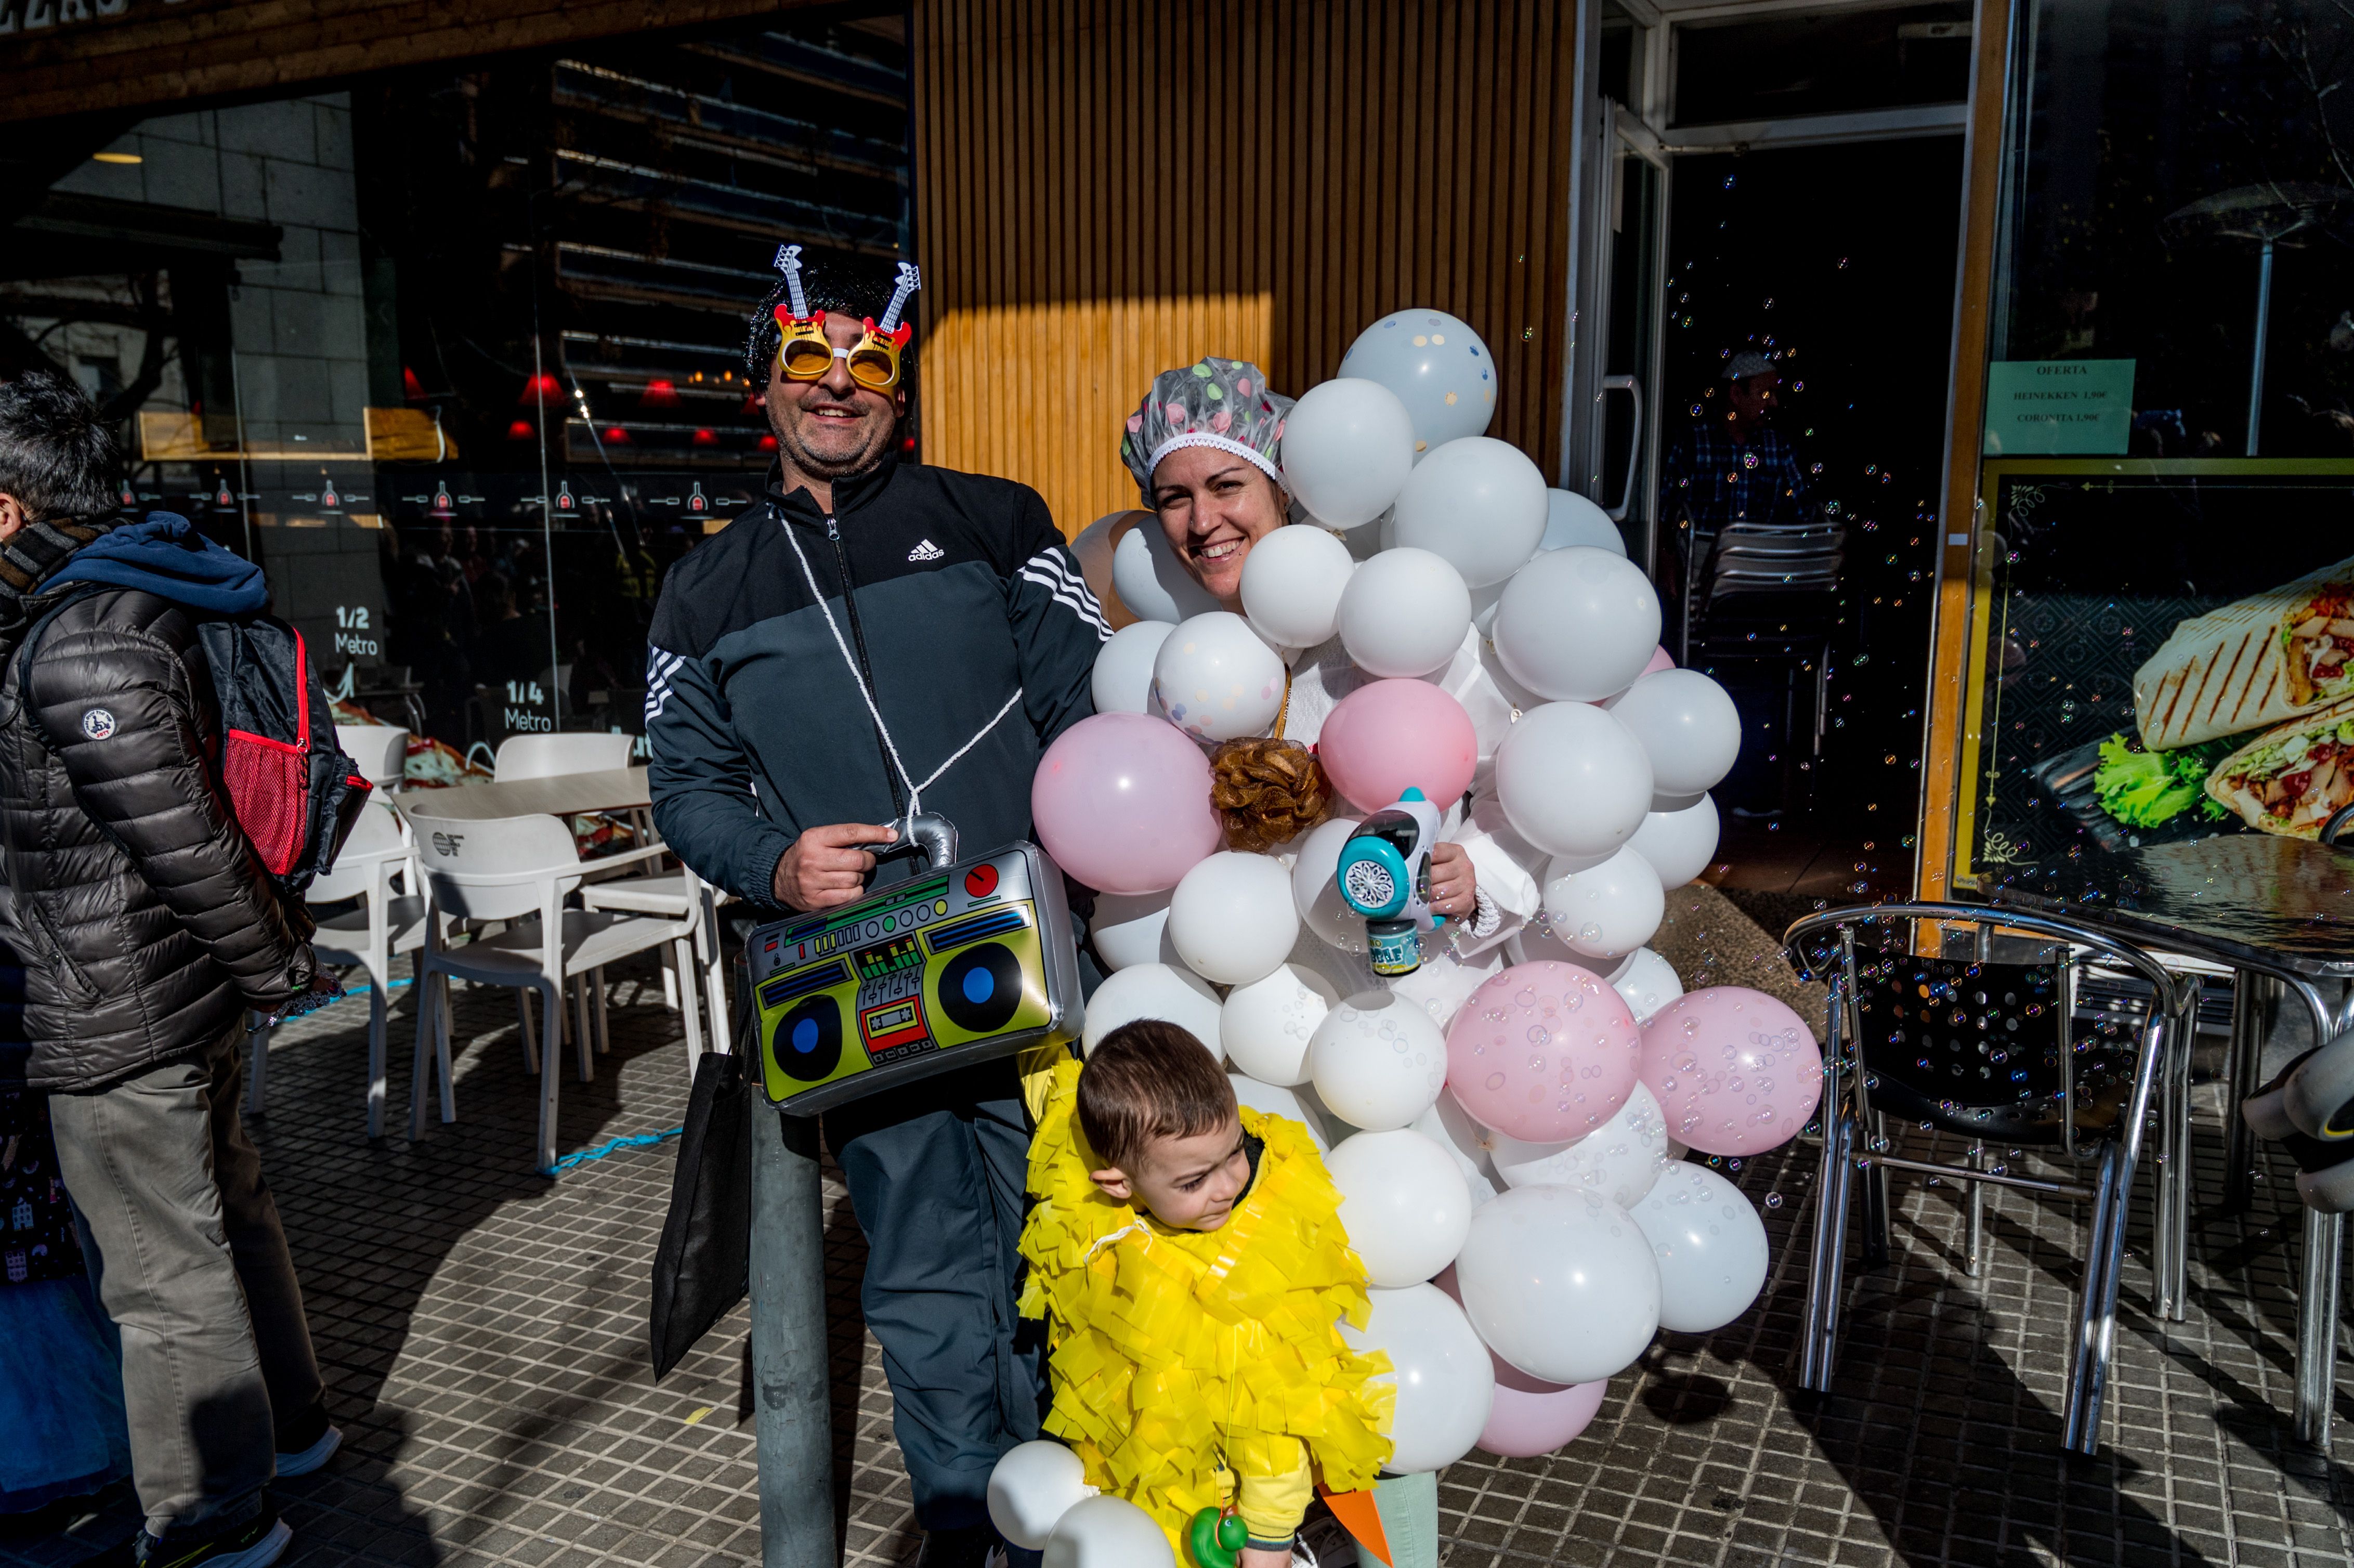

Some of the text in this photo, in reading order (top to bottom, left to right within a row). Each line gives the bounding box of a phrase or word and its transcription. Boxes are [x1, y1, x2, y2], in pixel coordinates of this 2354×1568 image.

[2037, 366, 2087, 375] OFERTA
[2014, 391, 2077, 400] HEINEKKEN
[2017, 414, 2073, 422] CORONITA
[908, 548, 945, 561] adidas
[335, 605, 370, 629] 1/2
[334, 632, 378, 656] Metro
[506, 679, 544, 705] 1/4
[504, 707, 551, 733] Metro
